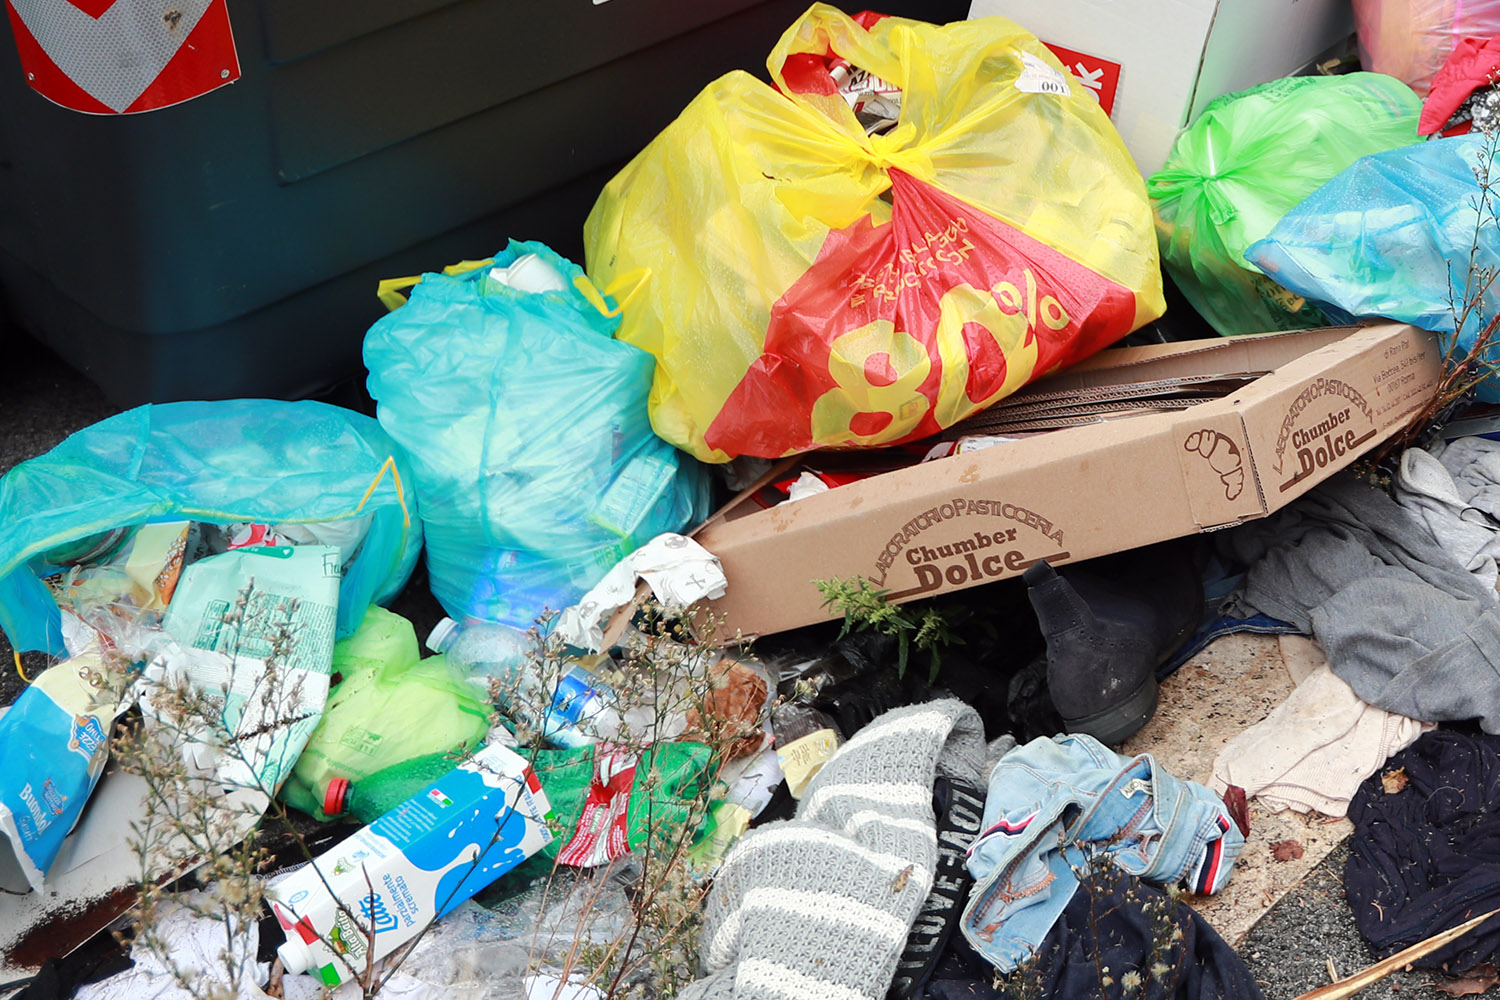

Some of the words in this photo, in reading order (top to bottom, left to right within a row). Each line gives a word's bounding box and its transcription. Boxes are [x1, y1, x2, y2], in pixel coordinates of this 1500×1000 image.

[811, 266, 1071, 447] 80%
[1291, 407, 1351, 450] Chumber
[1296, 429, 1356, 475] Dolce
[905, 528, 1018, 566] Chumber
[912, 550, 1026, 592] Dolce
[357, 892, 398, 936] Latte
[381, 872, 416, 929] parzialmente
[394, 875, 420, 915] scremato
